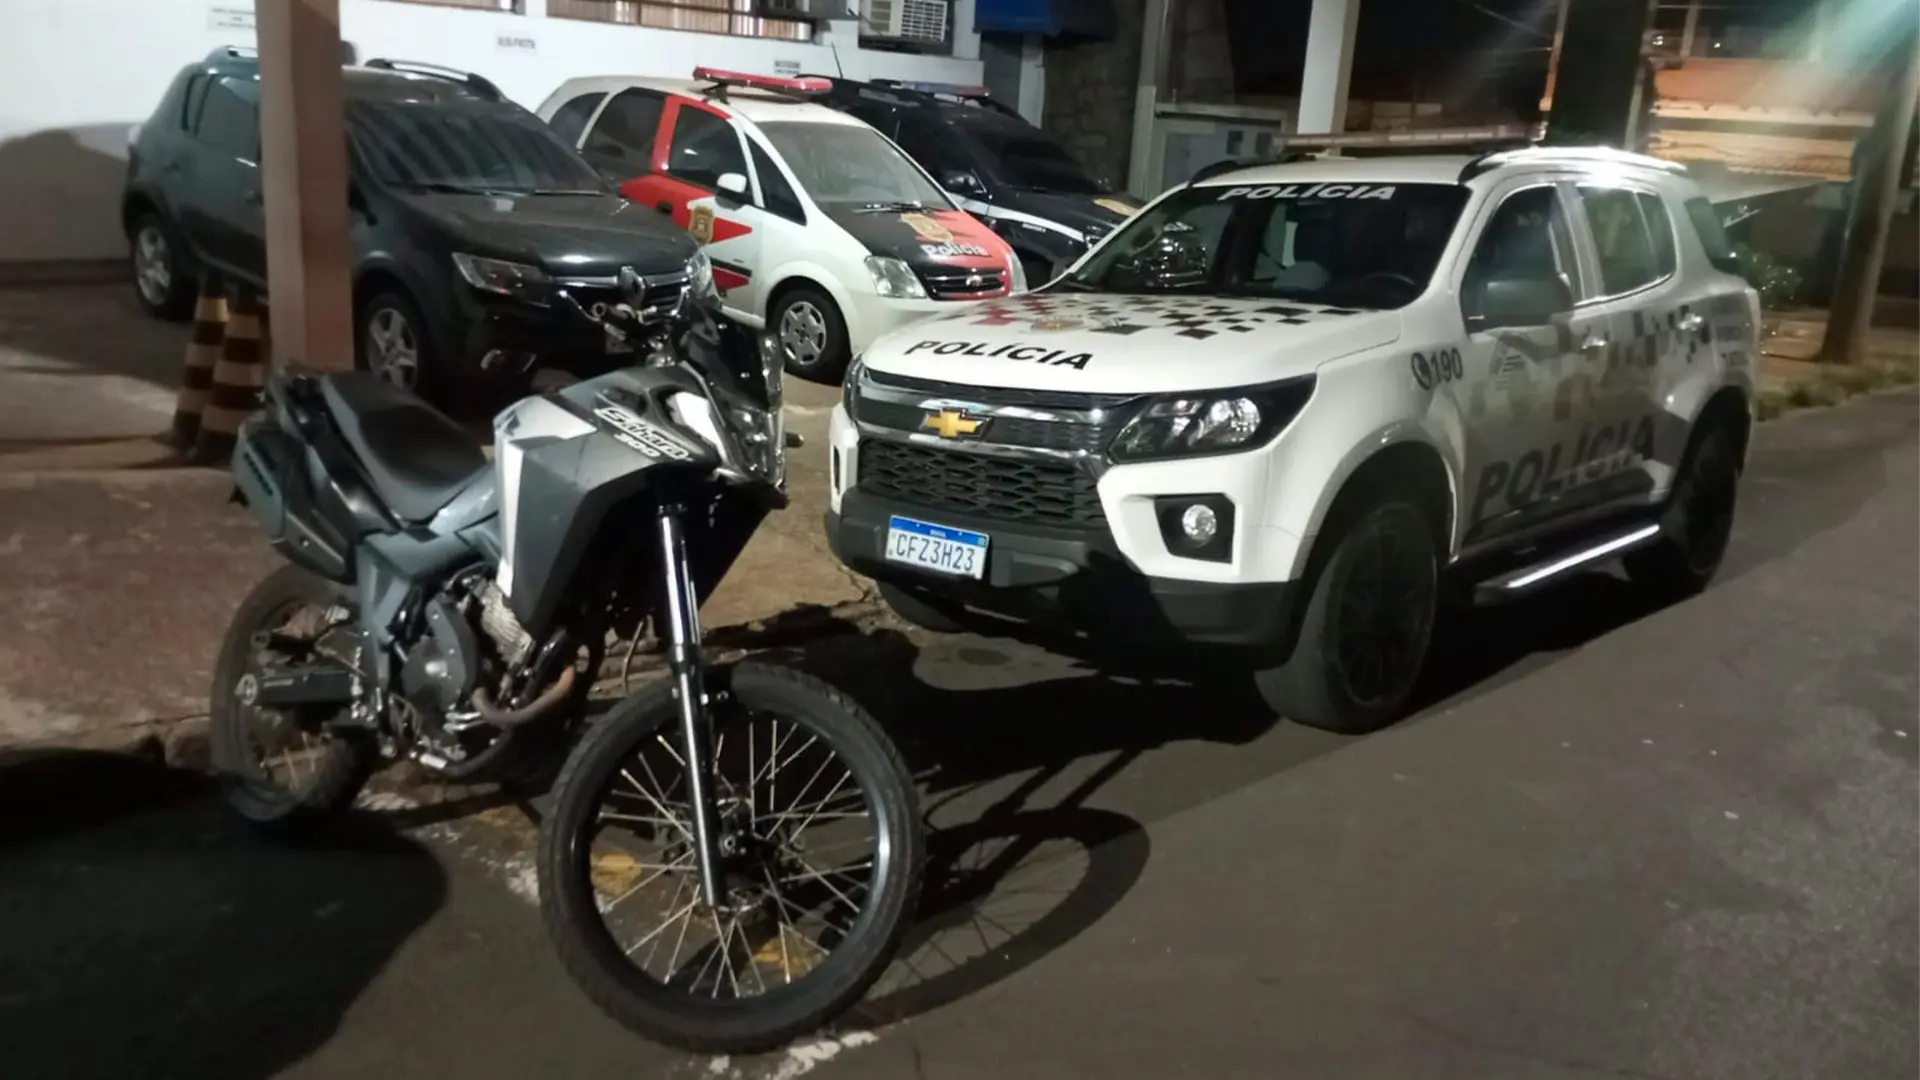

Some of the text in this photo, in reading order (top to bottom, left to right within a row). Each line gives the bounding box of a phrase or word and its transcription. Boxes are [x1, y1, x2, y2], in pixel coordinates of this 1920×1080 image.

[1217, 183, 1396, 201] POLÍCIA
[903, 340, 1093, 370] POLÍCIA
[1430, 347, 1463, 384] 190
[593, 406, 689, 460] Sahara
[1472, 413, 1654, 527] POLÍCIA
[896, 533, 976, 572] CFZ3H23
